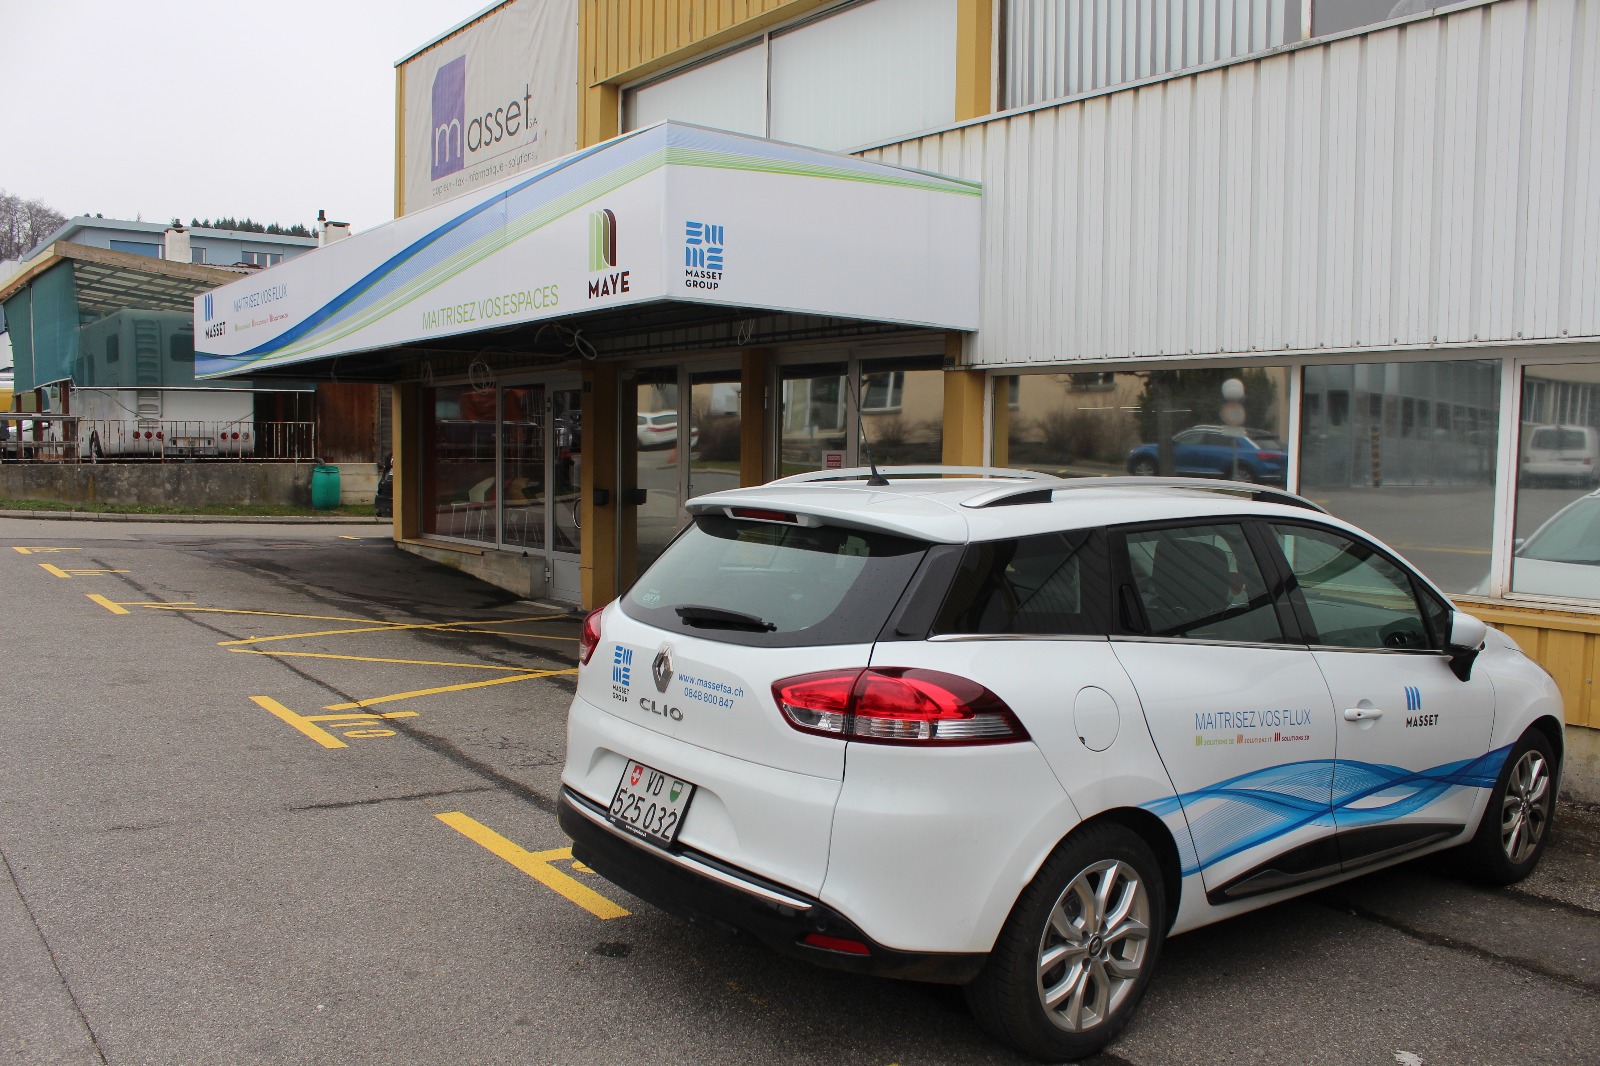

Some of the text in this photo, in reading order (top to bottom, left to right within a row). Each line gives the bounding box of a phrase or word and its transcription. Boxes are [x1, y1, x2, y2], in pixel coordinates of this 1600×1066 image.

[434, 83, 532, 167] masset
[588, 271, 630, 299] MAYE
[685, 268, 723, 281] MASSET
[685, 279, 719, 290] GROUP
[422, 284, 560, 330] MAITRISEZ VOS ESPACES
[205, 321, 226, 339] MASSET
[612, 684, 630, 695] MASSET
[678, 672, 744, 698] www.massetsa.ch
[612, 692, 628, 703] GROUP
[683, 687, 735, 710] 0848 800 847
[639, 697, 684, 722] CLIO
[1194, 708, 1311, 731] MAITRISEZ VOS FLUX
[1405, 713, 1439, 728] MASSET
[1281, 734, 1304, 742] SOLUTIONS
[646, 771, 665, 797] VD
